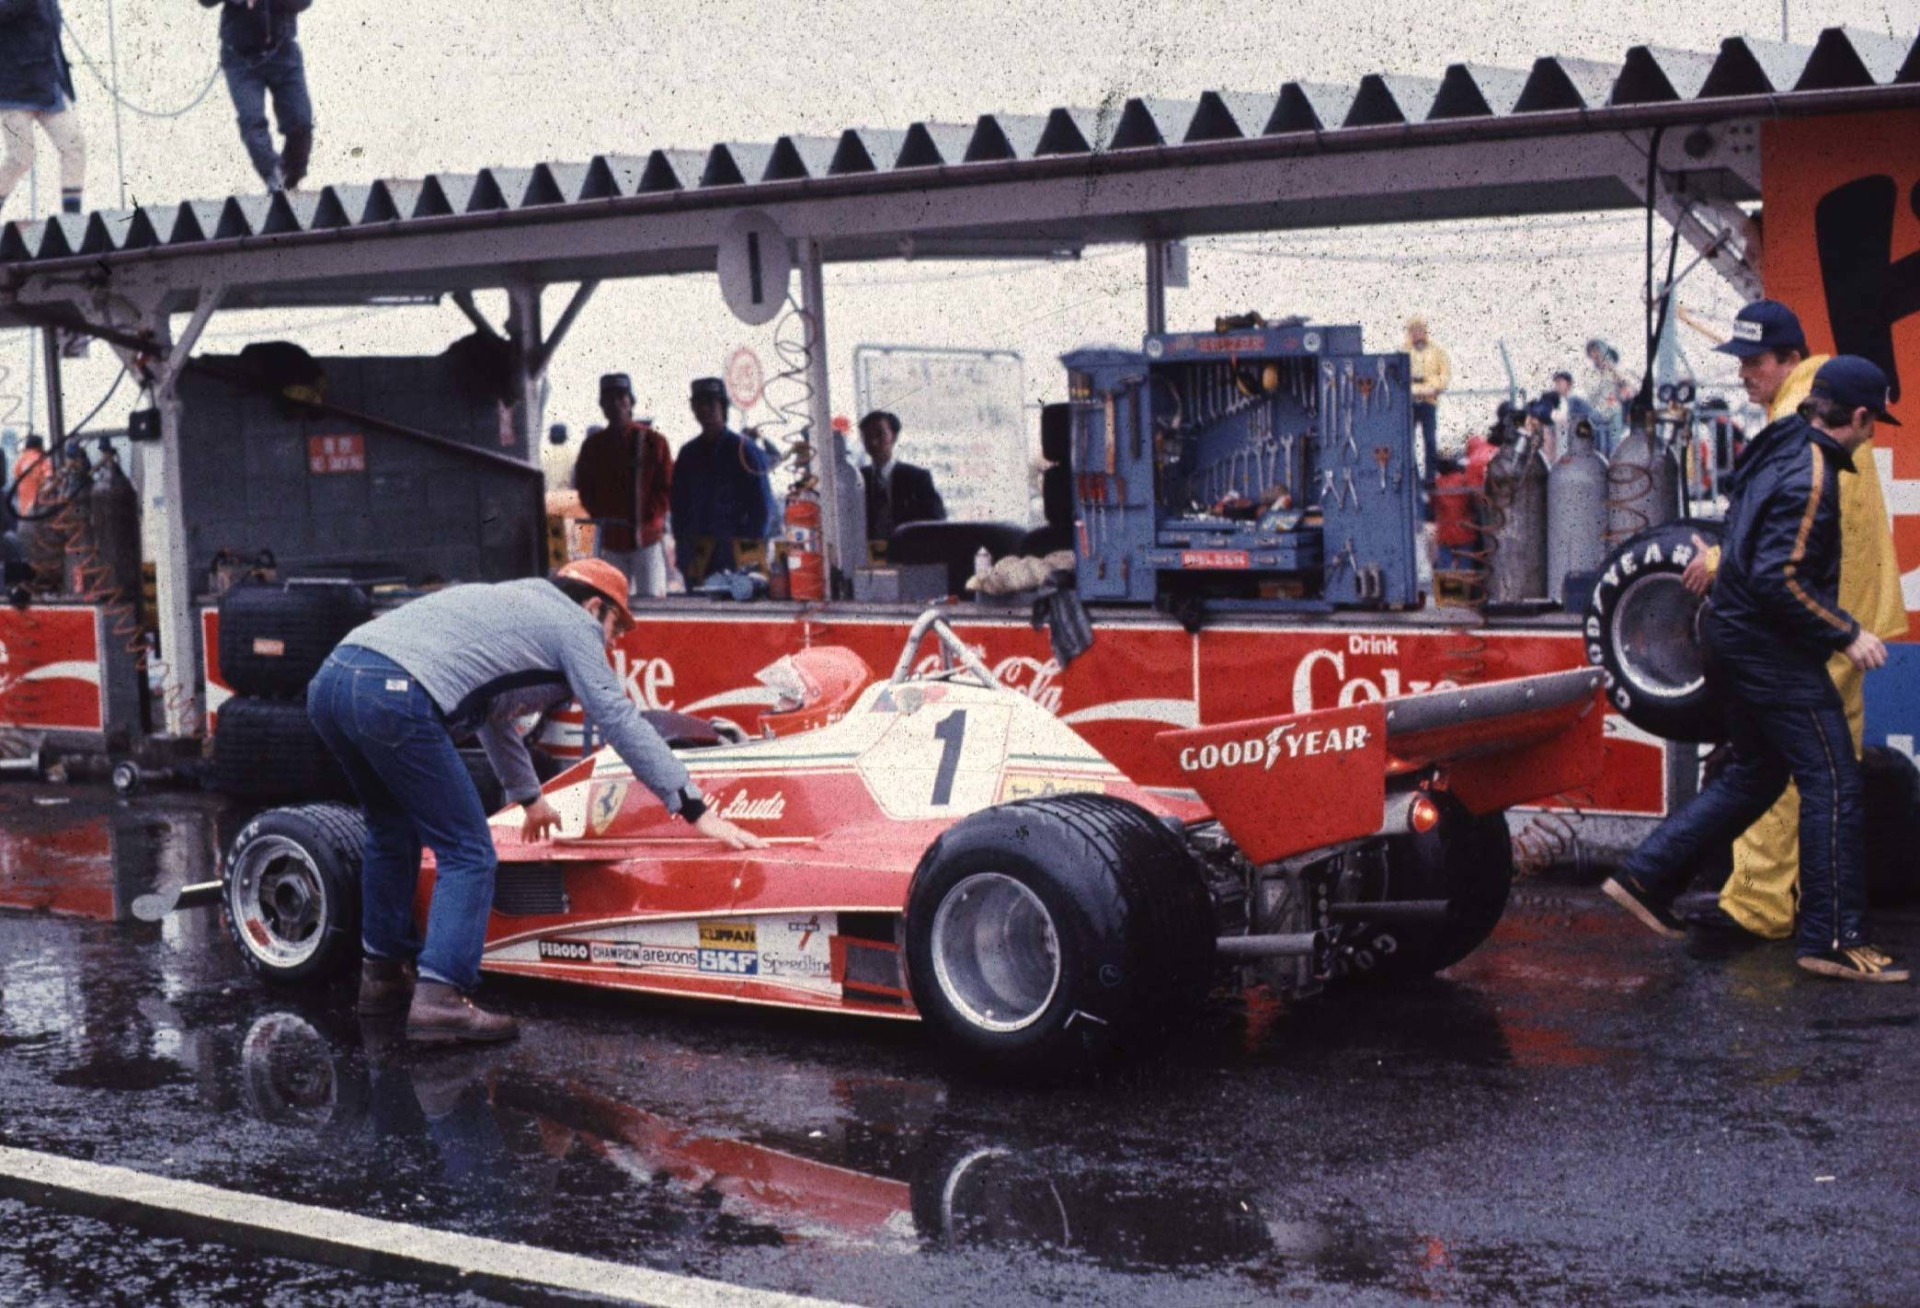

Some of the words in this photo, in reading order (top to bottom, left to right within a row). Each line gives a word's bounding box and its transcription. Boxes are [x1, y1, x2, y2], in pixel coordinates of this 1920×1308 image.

[1349, 635, 1398, 655] Drink
[612, 648, 675, 711] ke
[930, 708, 967, 806] 1
[720, 788, 786, 819] Lauda
[540, 941, 589, 959] FERODO
[592, 945, 640, 962] CHAMPION
[642, 948, 697, 965] arexons
[701, 949, 757, 973] SKF
